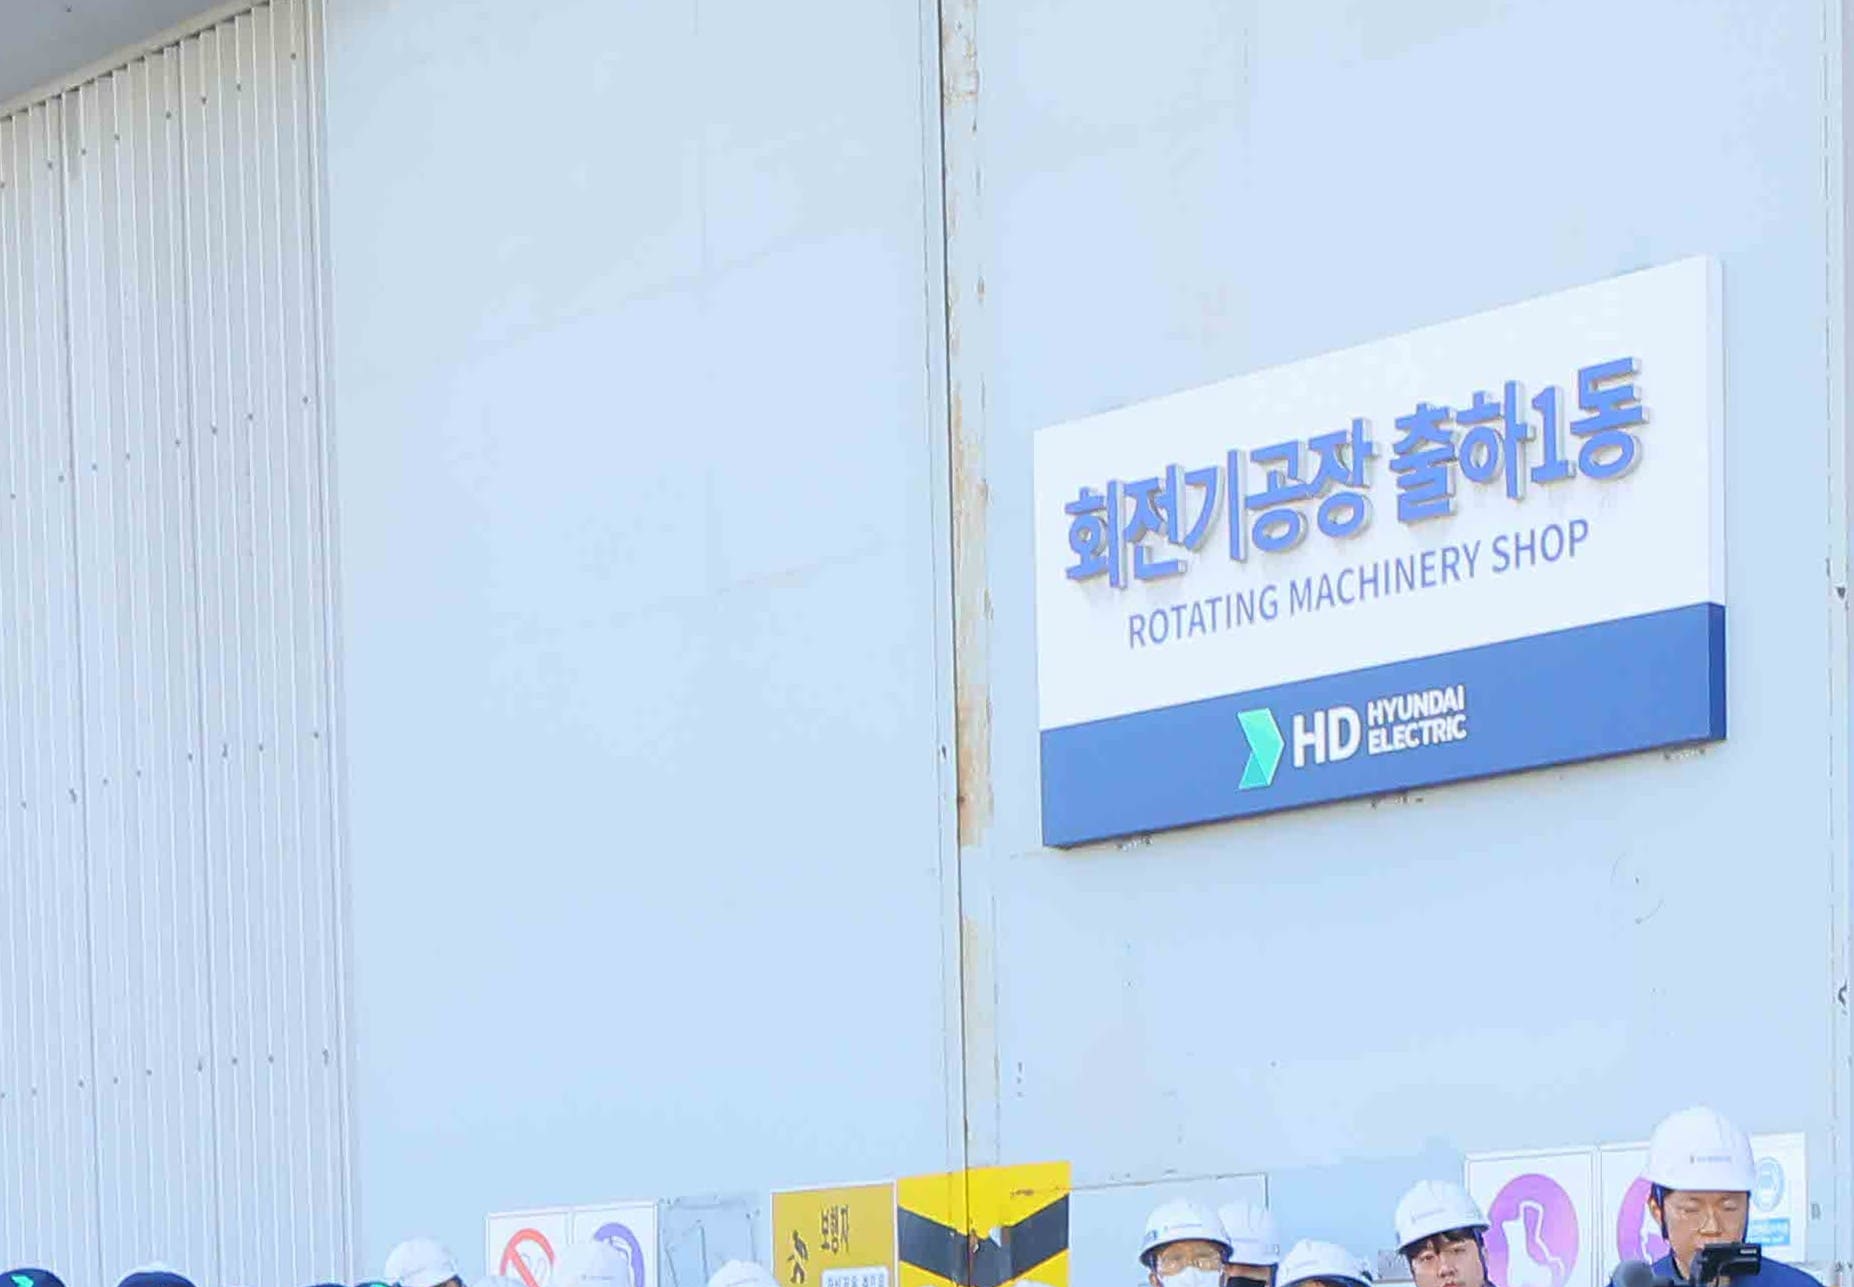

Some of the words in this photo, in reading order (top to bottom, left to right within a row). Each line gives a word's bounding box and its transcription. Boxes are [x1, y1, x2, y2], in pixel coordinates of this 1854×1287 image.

[1065, 417, 1377, 591] 회전기공장
[1392, 355, 1651, 525] 출하1동
[1128, 585, 1279, 649] ROTATING
[1288, 541, 1480, 617] MACHINERY
[1491, 518, 1589, 576] SHOP
[1367, 685, 1466, 730] HYUNDAI
[1368, 715, 1467, 755] ELECTRIC
[1293, 708, 1361, 768] HD
